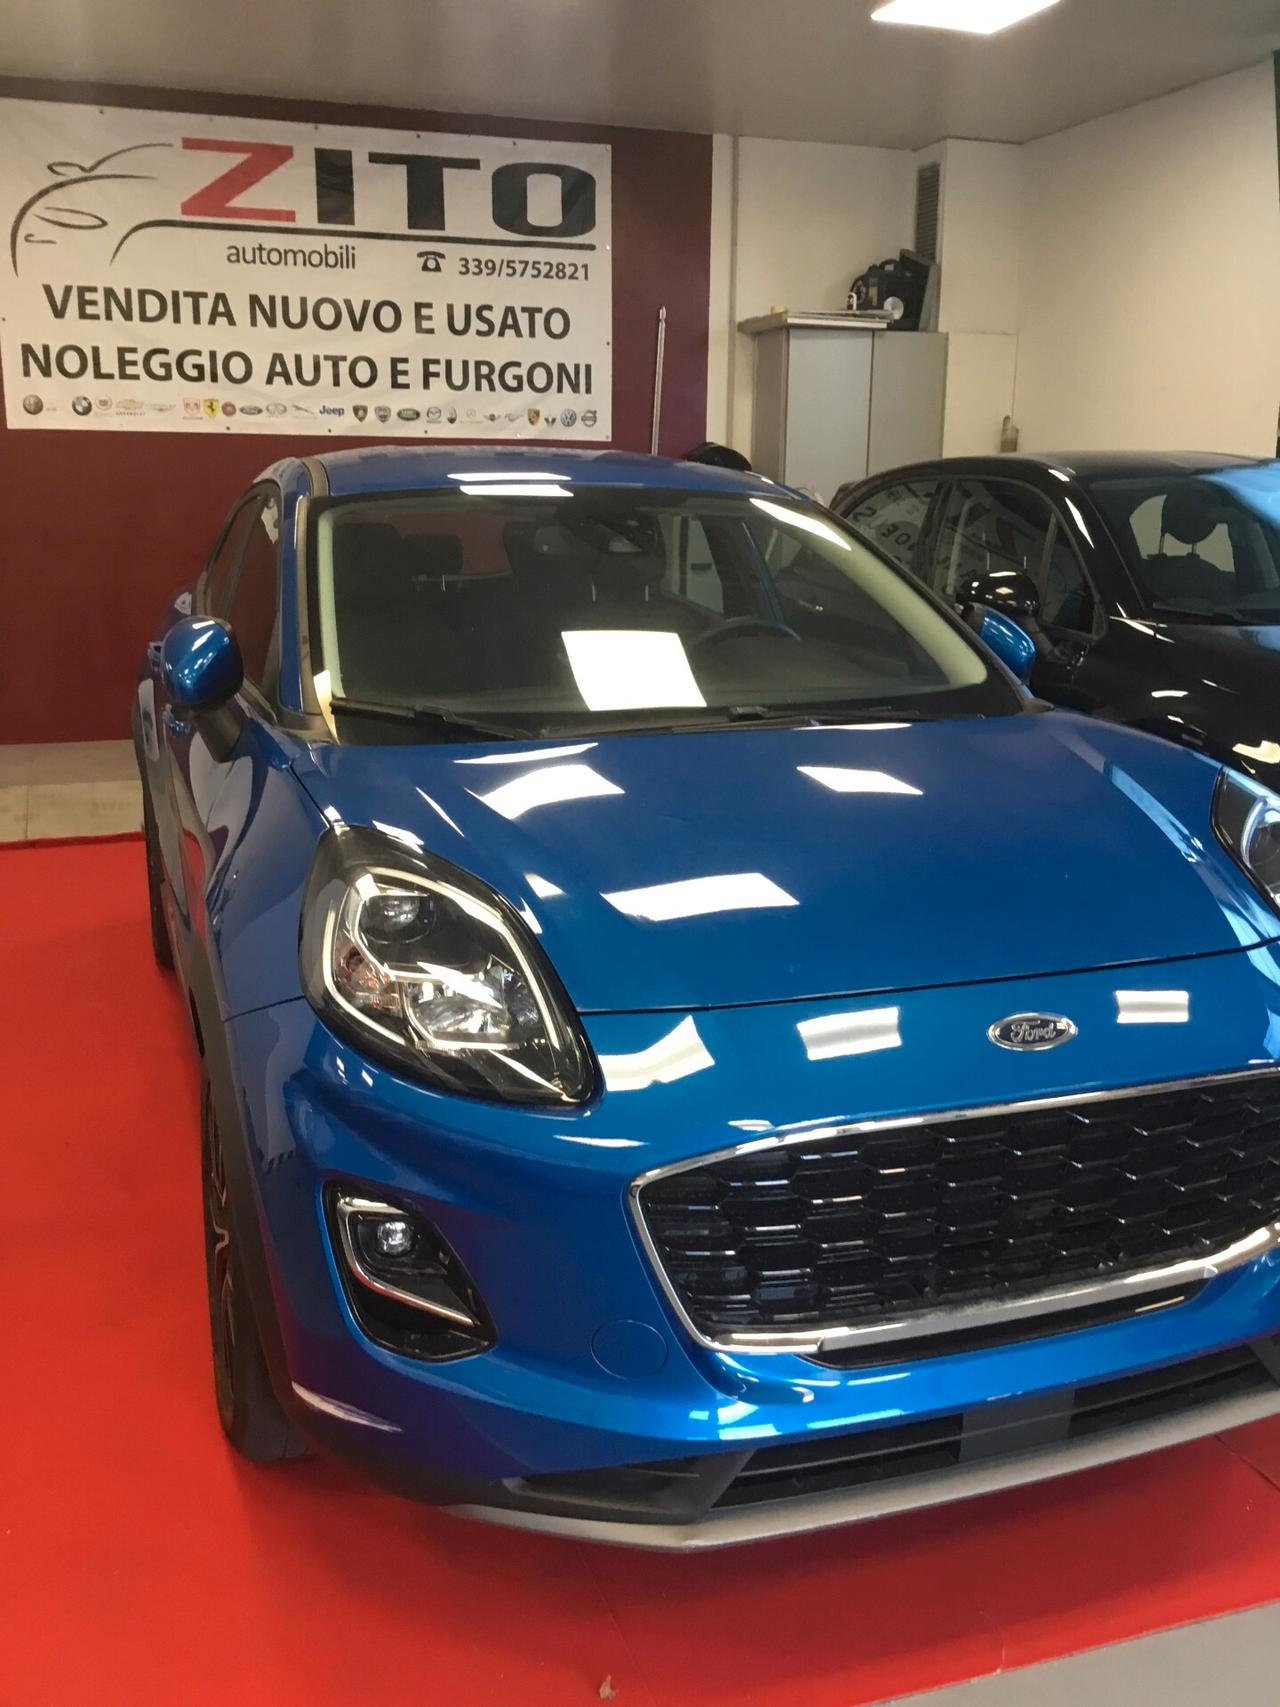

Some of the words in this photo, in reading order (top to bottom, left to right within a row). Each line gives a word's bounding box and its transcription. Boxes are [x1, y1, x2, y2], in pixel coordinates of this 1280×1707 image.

[181, 137, 597, 238] ZITO
[226, 243, 357, 270] automobili
[458, 257, 590, 281] 339/5752821
[42, 283, 237, 327] VENDITA
[248, 293, 402, 334] NUOVO
[413, 301, 436, 335] E
[446, 303, 571, 340] USATO
[21, 343, 253, 385] NOLEGGIO
[264, 353, 378, 389] AUTO
[389, 356, 411, 390] E
[421, 357, 592, 395] FURGONI
[318, 405, 345, 418] Jeep
[1010, 1020, 1056, 1043] Ford
